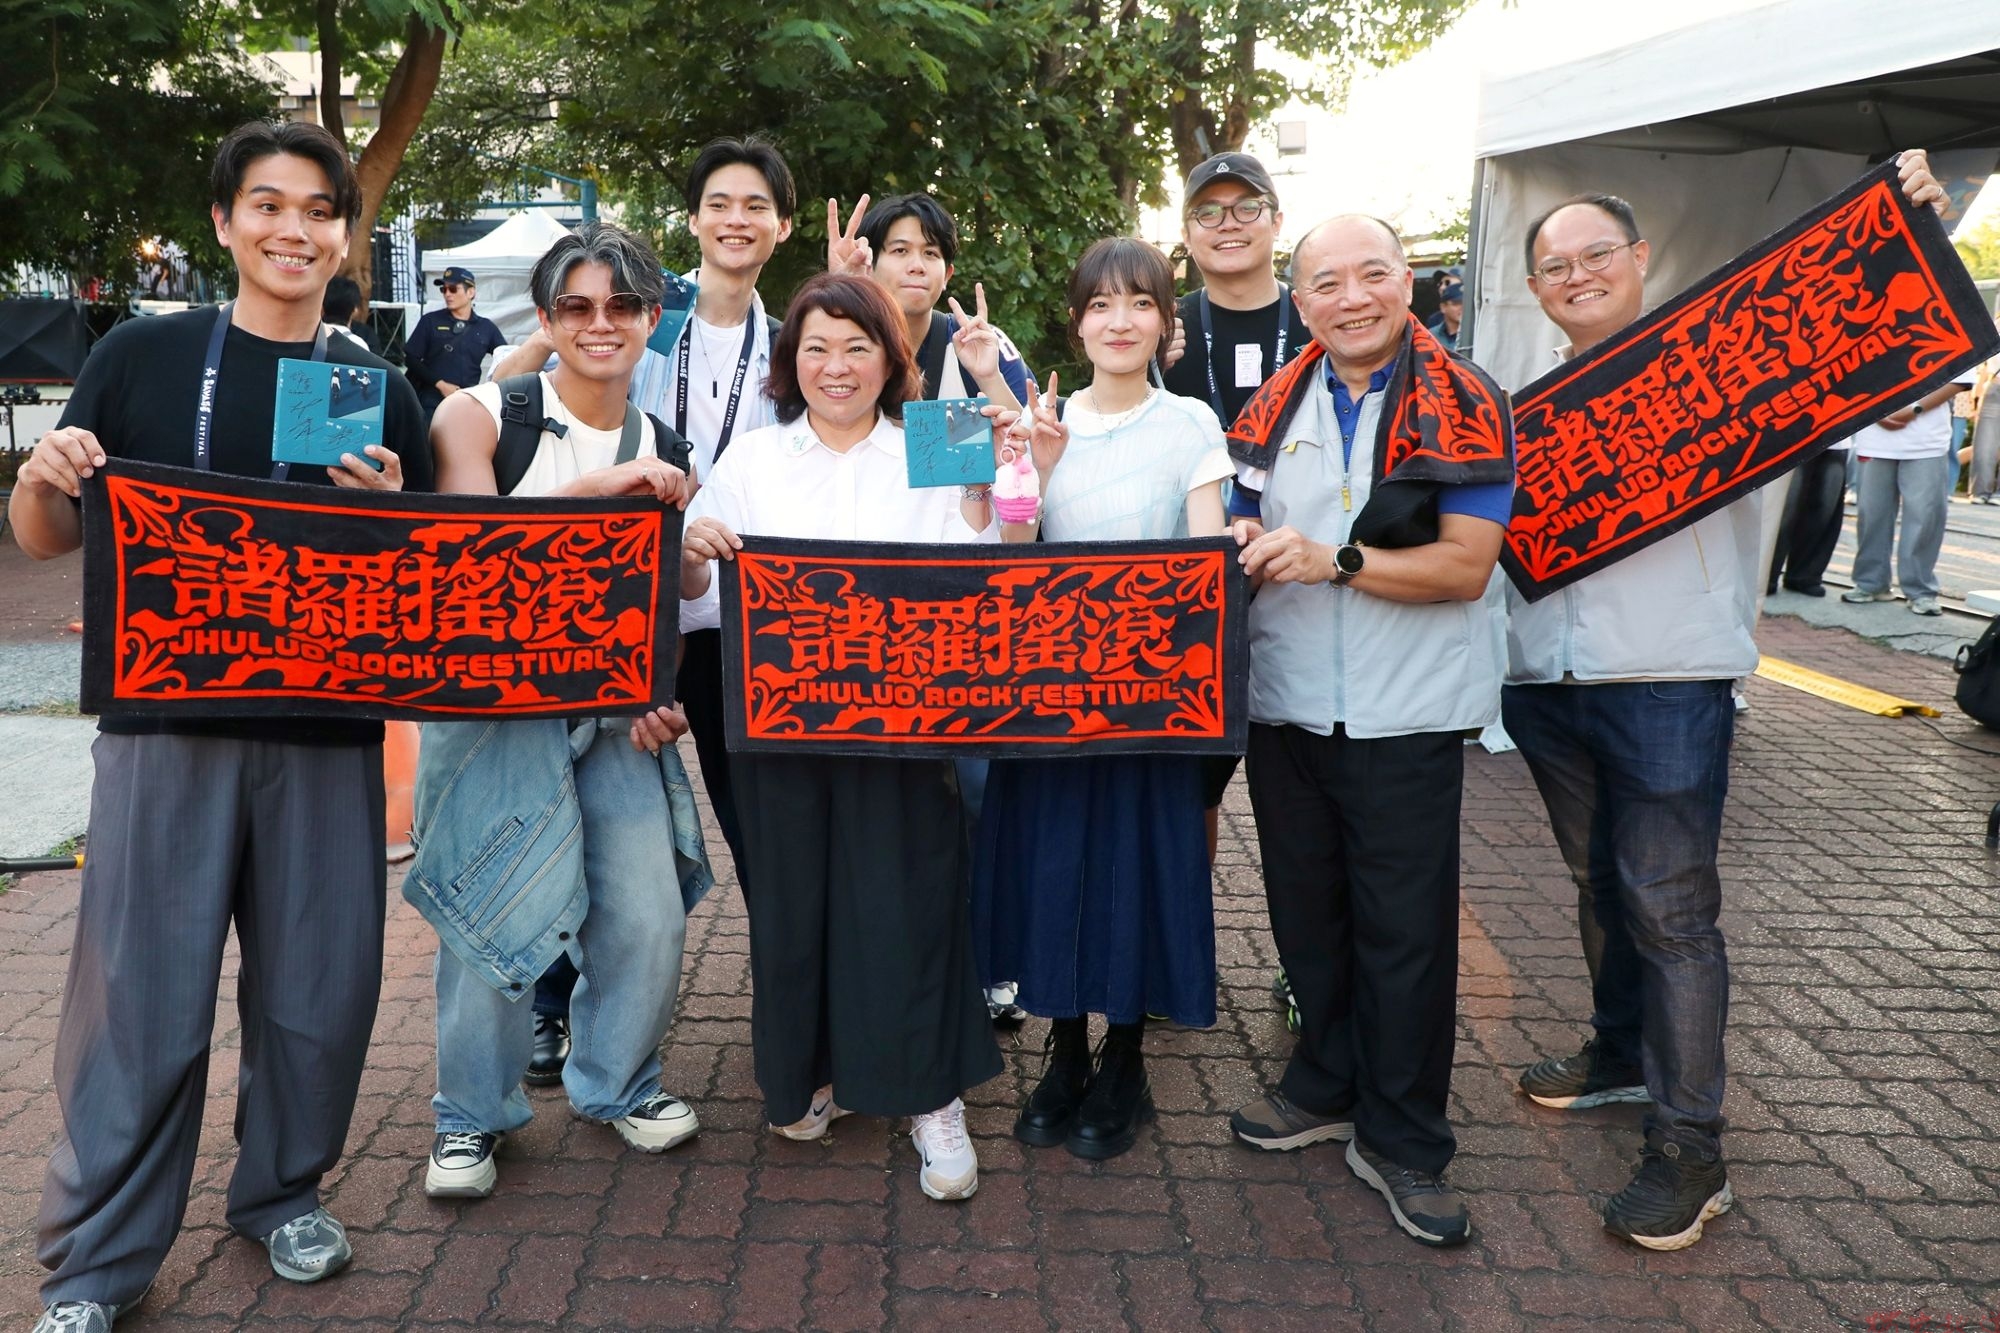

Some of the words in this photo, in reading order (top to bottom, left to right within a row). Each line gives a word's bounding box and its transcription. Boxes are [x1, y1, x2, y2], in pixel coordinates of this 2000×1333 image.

[197, 416, 207, 456] FESTIVAL
[725, 398, 736, 427] FESTIVAL
[1546, 468, 1661, 536] JHULUO
[1750, 326, 1911, 429] FESTIVAL
[168, 532, 616, 642] 諸羅搖滾
[169, 630, 325, 661] JHULUO
[445, 648, 613, 678] FESTIVAL
[785, 590, 1184, 676] 諸羅搖滾
[787, 681, 917, 706] JHULUO
[1020, 680, 1181, 706] FESTIVAL
